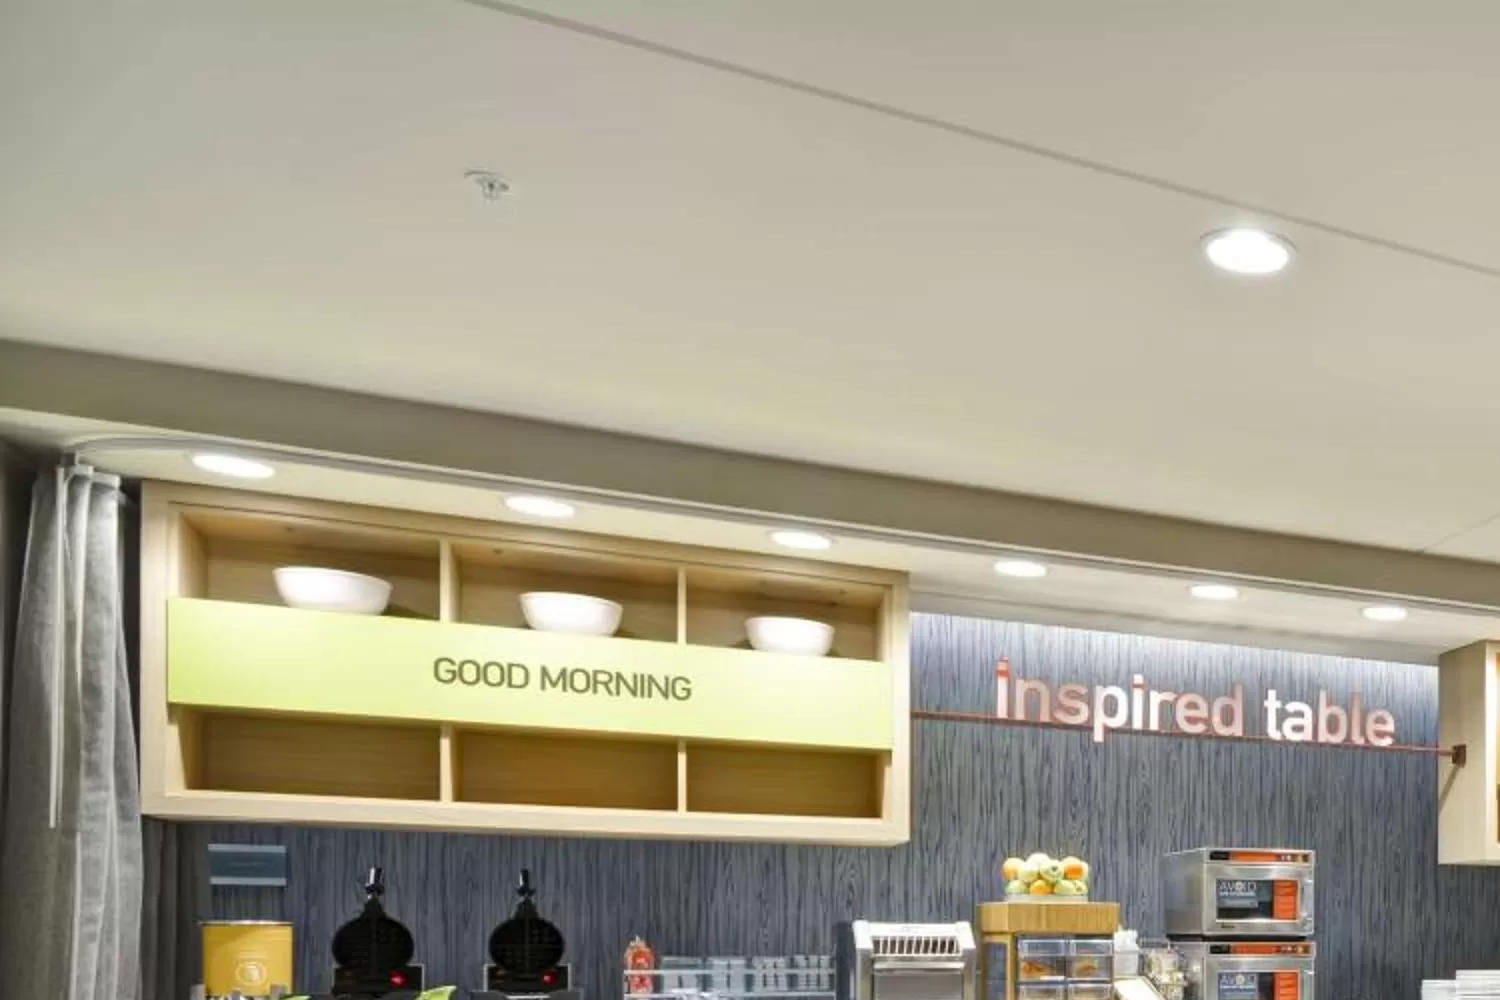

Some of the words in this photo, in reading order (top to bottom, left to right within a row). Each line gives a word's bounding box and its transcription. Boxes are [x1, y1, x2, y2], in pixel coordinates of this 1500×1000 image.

[433, 657, 530, 689] GOOD
[540, 665, 692, 701] MORNING
[995, 657, 1246, 743] inspired
[1263, 687, 1395, 747] table
